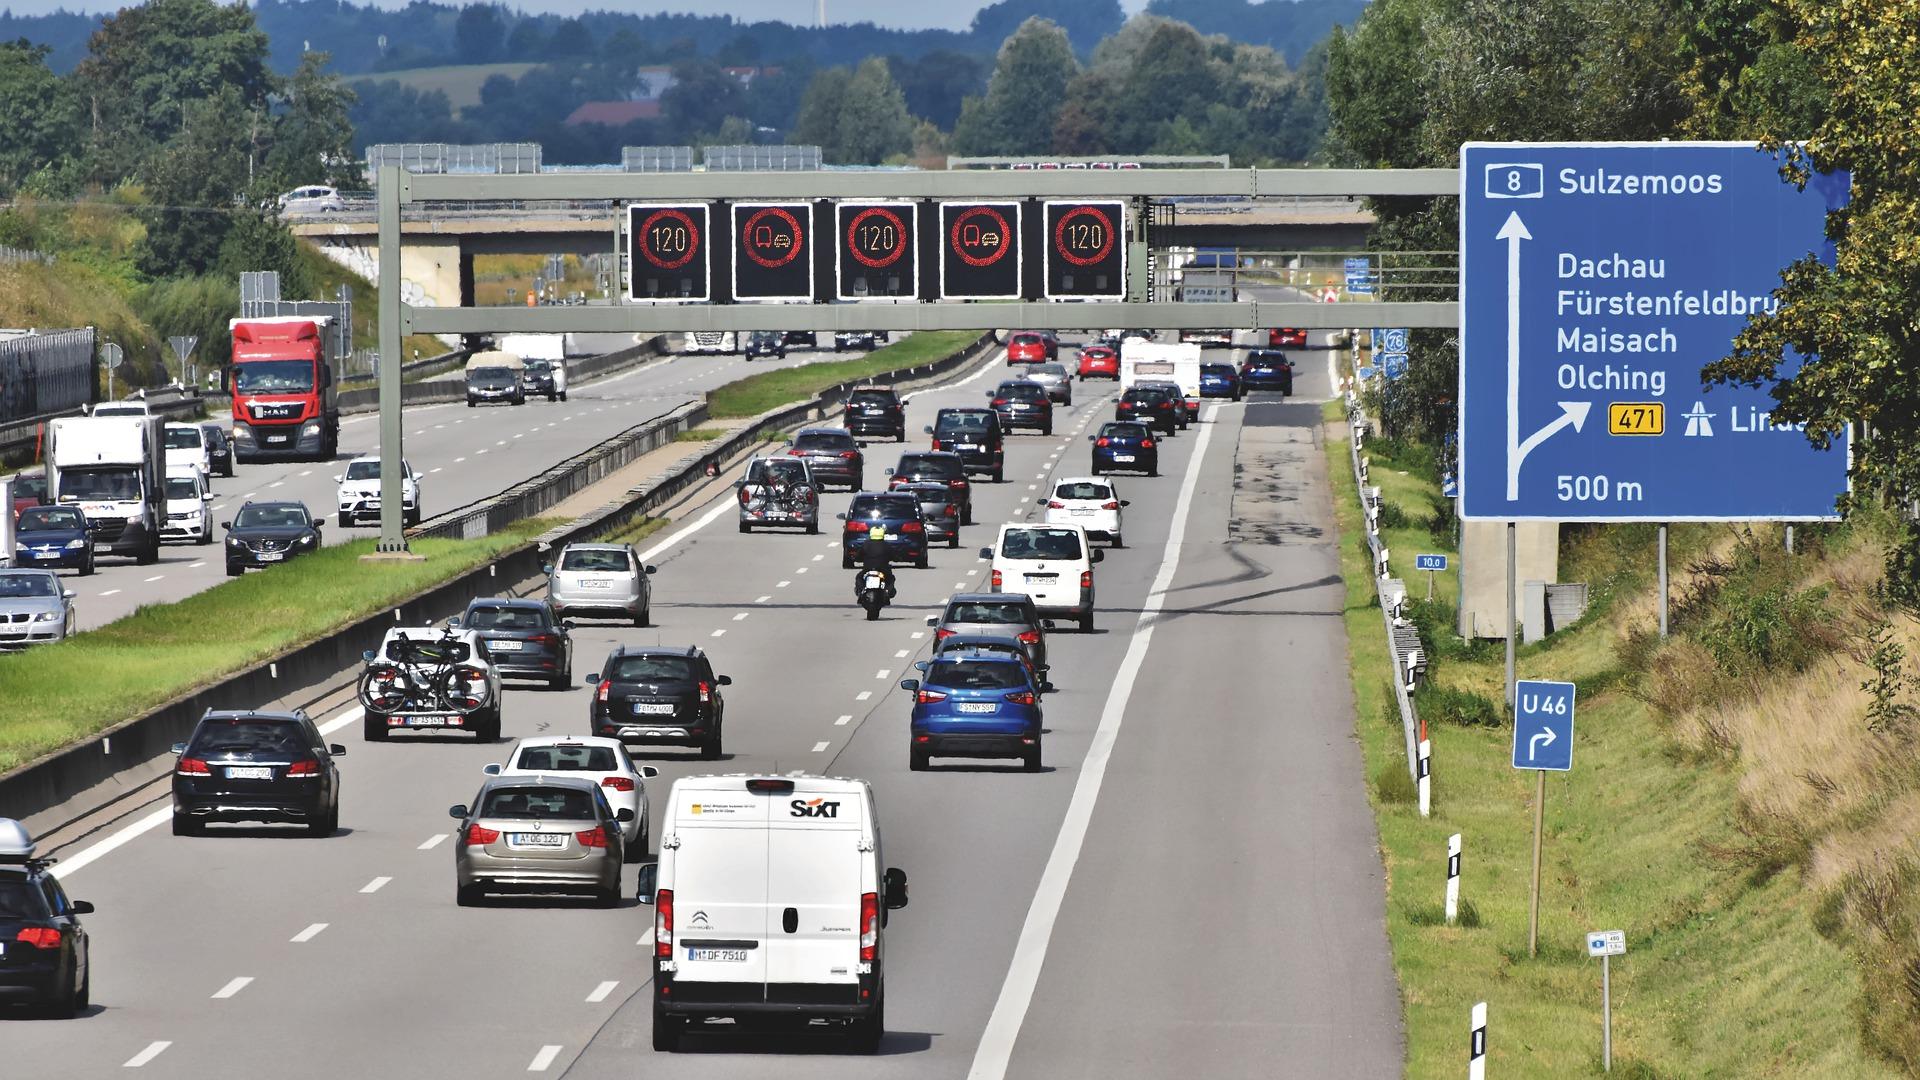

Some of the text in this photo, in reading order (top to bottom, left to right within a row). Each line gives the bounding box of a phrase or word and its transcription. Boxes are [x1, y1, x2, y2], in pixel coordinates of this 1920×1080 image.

[1507, 168, 1722, 195] 8 Sulzemoos
[652, 226, 686, 253] 120
[860, 225, 894, 252] 120
[1068, 224, 1102, 250] 120
[1558, 252, 1665, 279] Dachau
[1558, 289, 1780, 316] Fürstenfeldbru
[1558, 327, 1677, 353] Maisach
[1558, 363, 1666, 397] Olching
[1619, 406, 1809, 432] 471 Lin
[1557, 475, 1642, 501] 500 m
[1523, 694, 1566, 715] U 46
